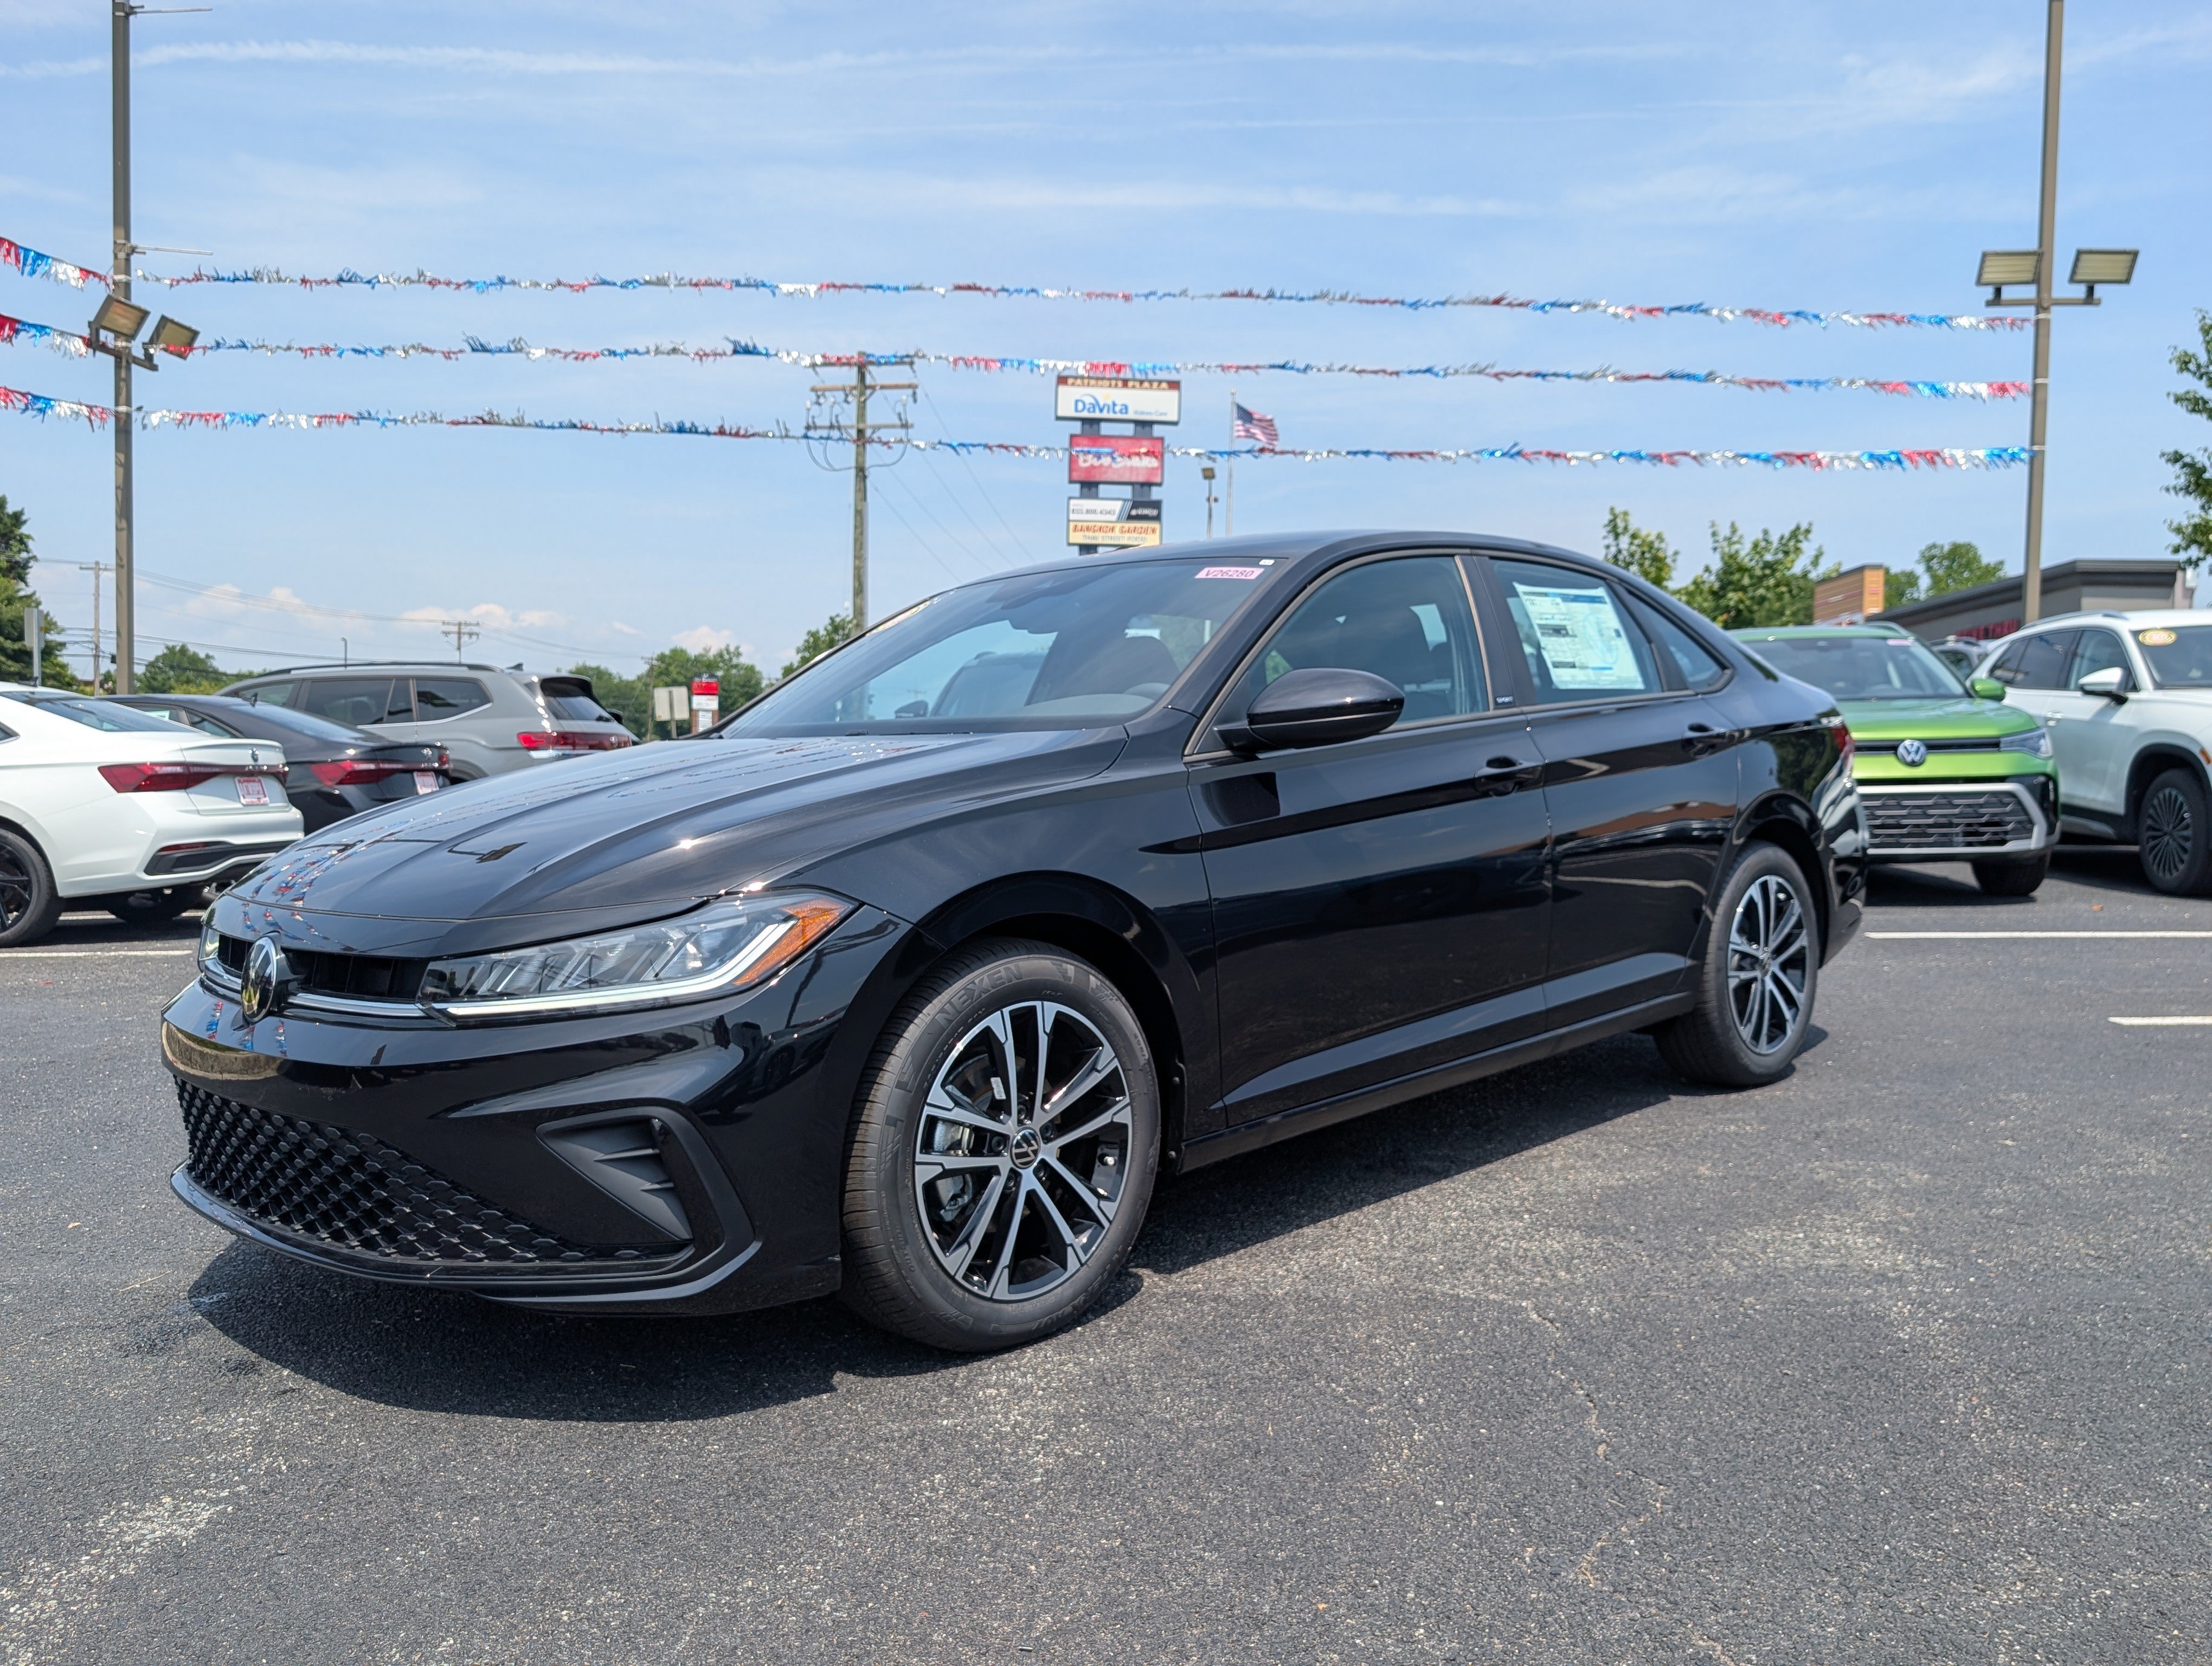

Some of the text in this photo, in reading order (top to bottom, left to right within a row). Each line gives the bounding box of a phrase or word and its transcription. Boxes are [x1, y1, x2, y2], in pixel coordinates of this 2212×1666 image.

[1074, 396, 1129, 415] DaVita
[1072, 523, 1158, 535] BANGKOK GARDEN
[1205, 569, 1255, 578] V26280
[934, 962, 1024, 1028] NEXEN
